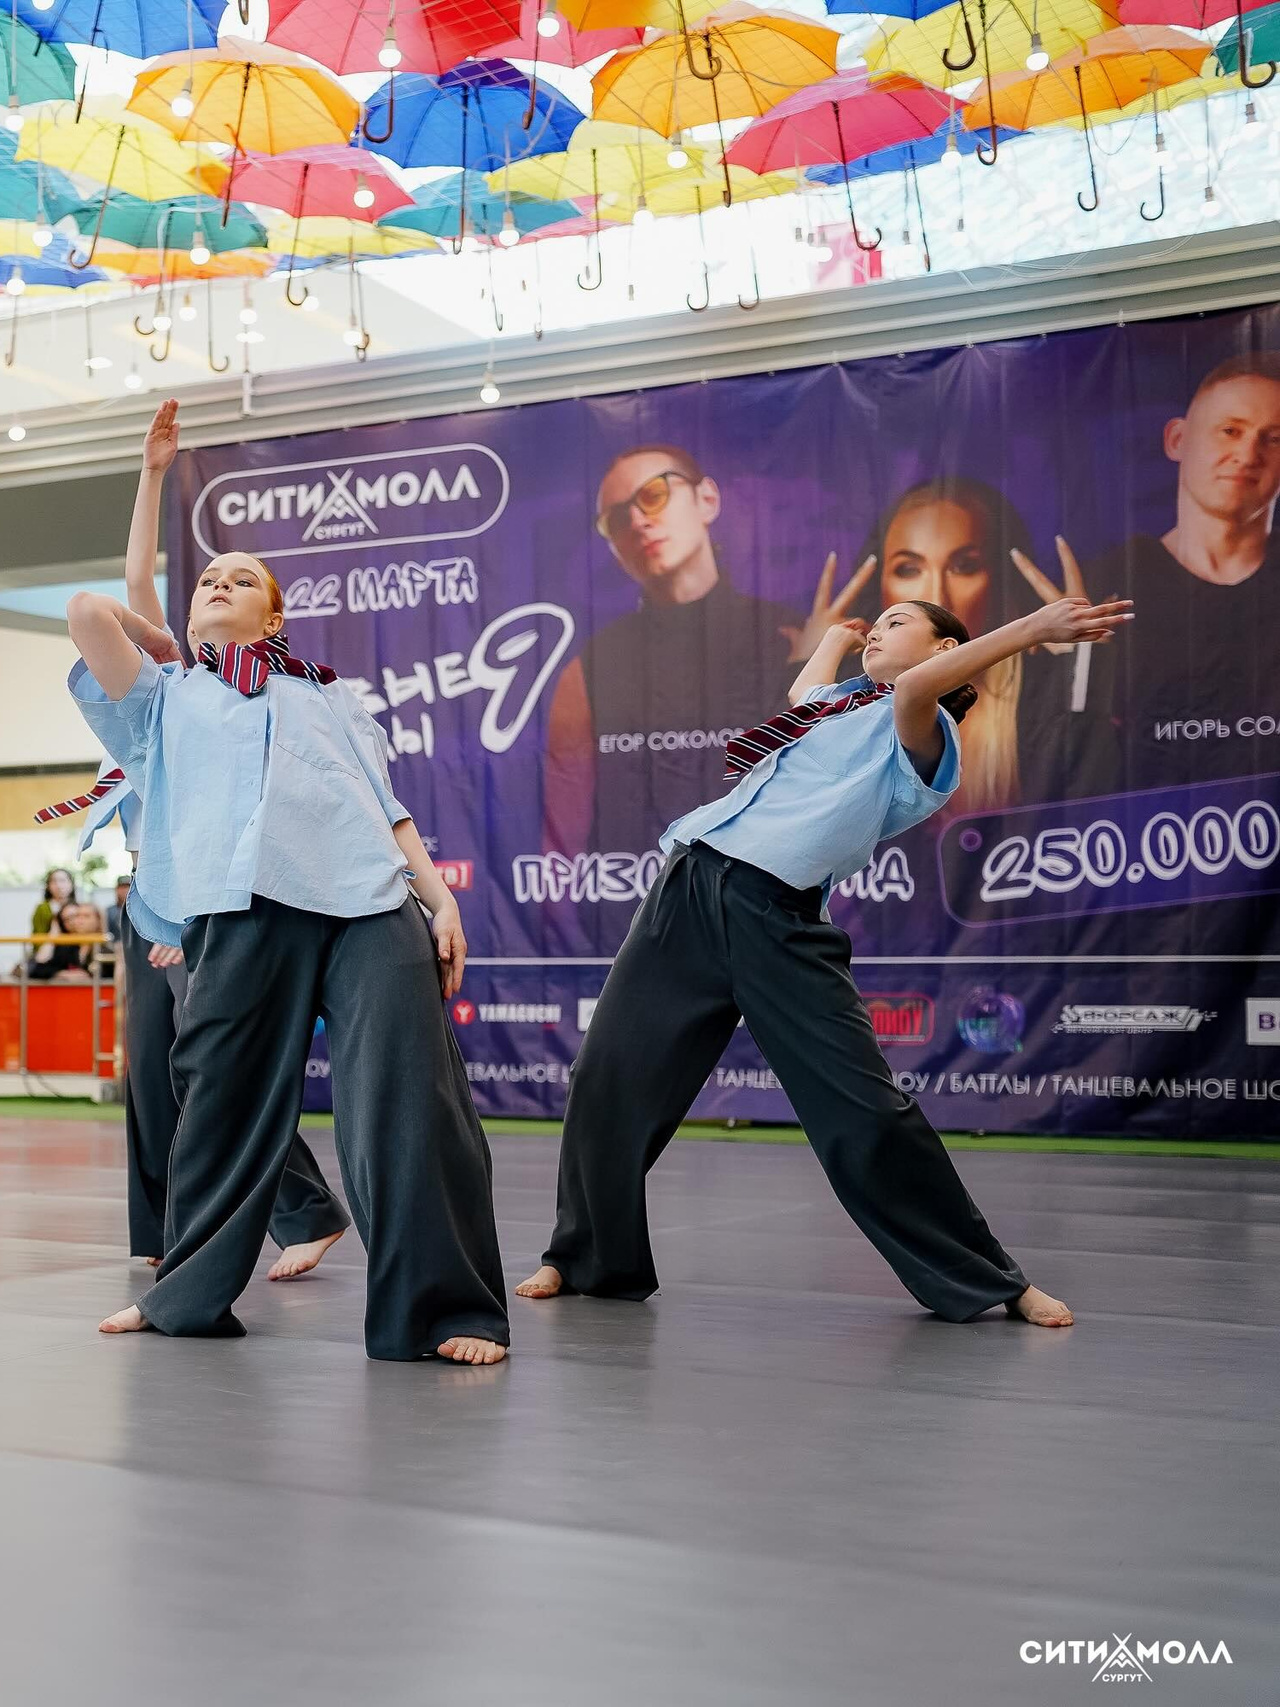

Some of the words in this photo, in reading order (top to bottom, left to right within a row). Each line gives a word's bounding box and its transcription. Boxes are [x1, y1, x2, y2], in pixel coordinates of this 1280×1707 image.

[217, 481, 324, 526] СИТИ
[355, 464, 482, 509] МОЛЛ
[347, 556, 478, 613] МАРТА
[599, 732, 645, 753] ЕГОР
[647, 727, 745, 751] СОКОЛО
[1154, 718, 1231, 741] ИГОРЬ
[512, 850, 666, 903] ПРИЗО
[980, 800, 1280, 902] 250.000
[950, 1072, 1031, 1095] БАТТЛЫ
[1052, 1075, 1236, 1100] ТАНЦЕВАЛЬНОЕ
